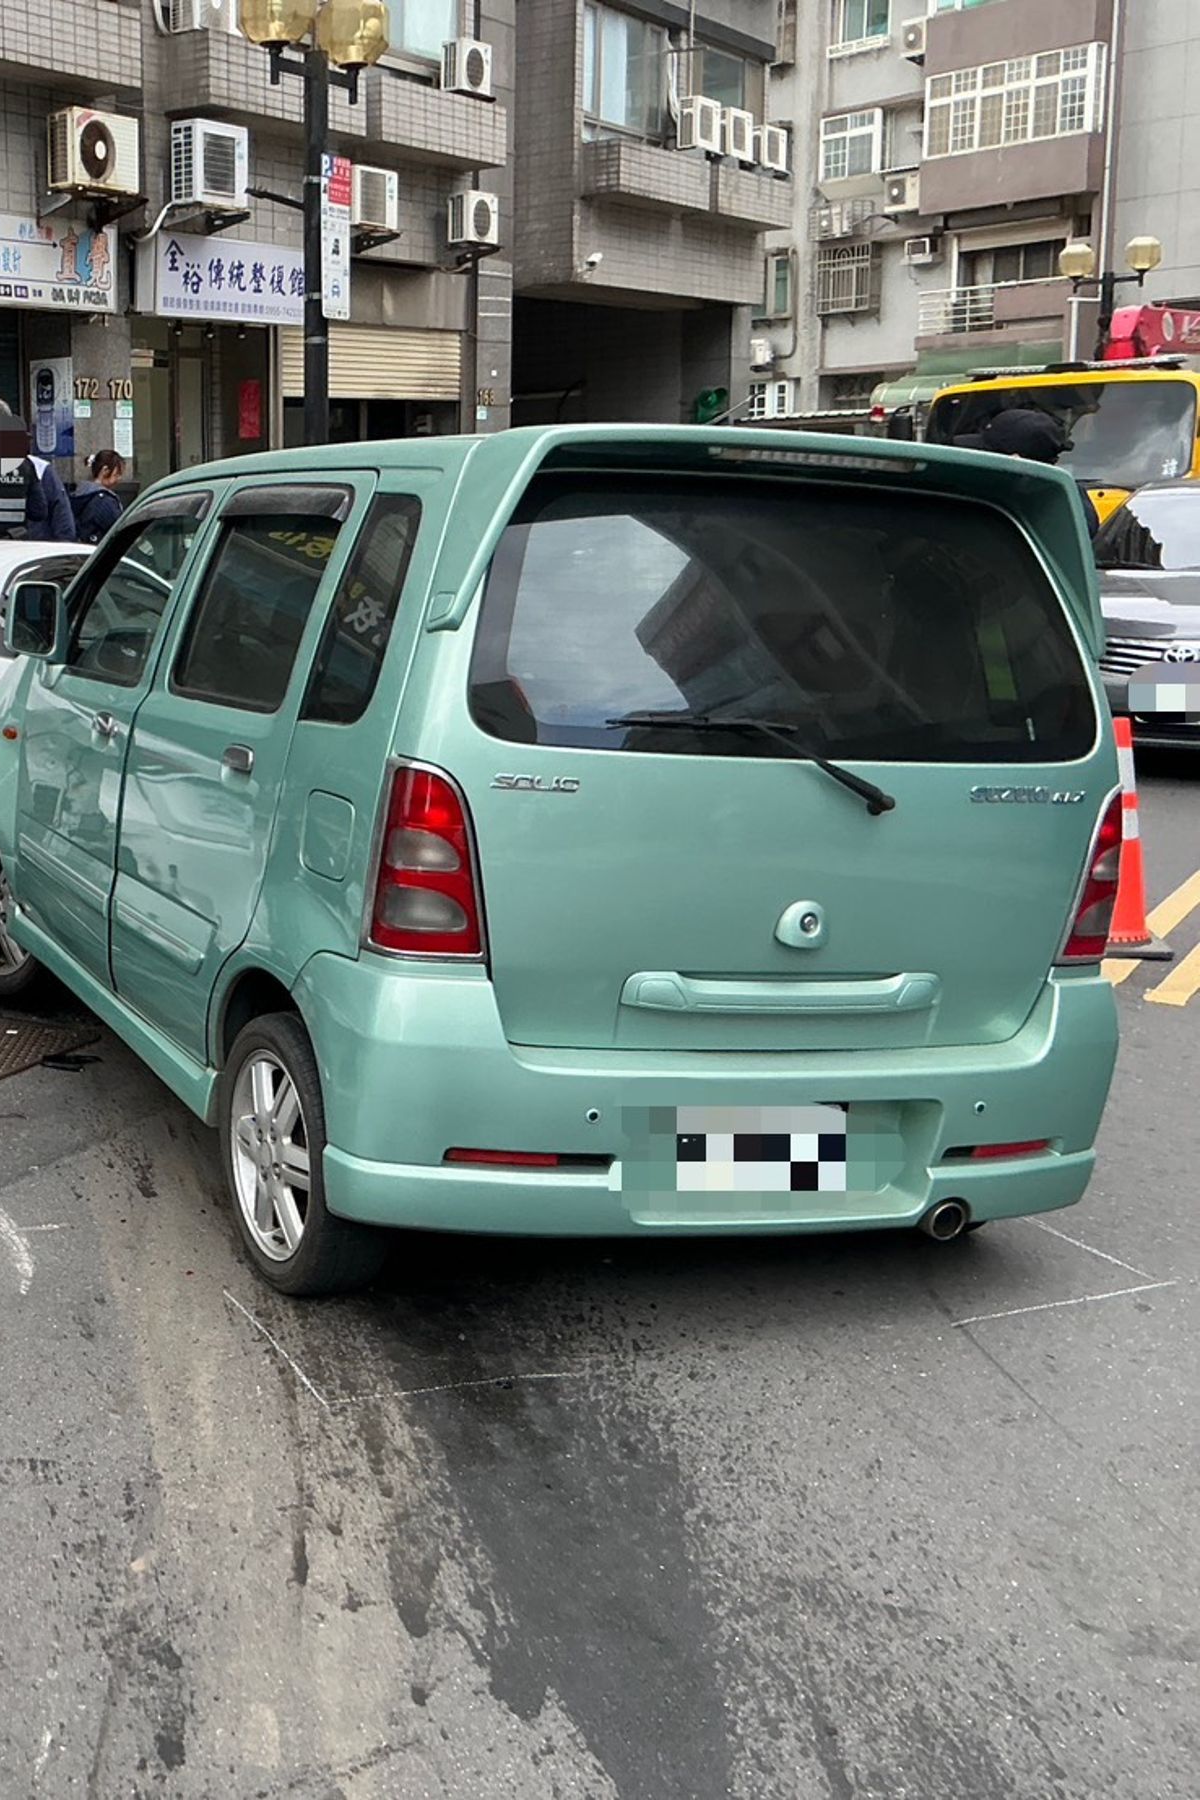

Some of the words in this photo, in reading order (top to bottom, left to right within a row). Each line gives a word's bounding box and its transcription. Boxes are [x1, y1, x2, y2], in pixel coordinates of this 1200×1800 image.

[74, 377, 100, 399] 172
[109, 379, 133, 400] 170
[489, 772, 581, 793] SOLIO
